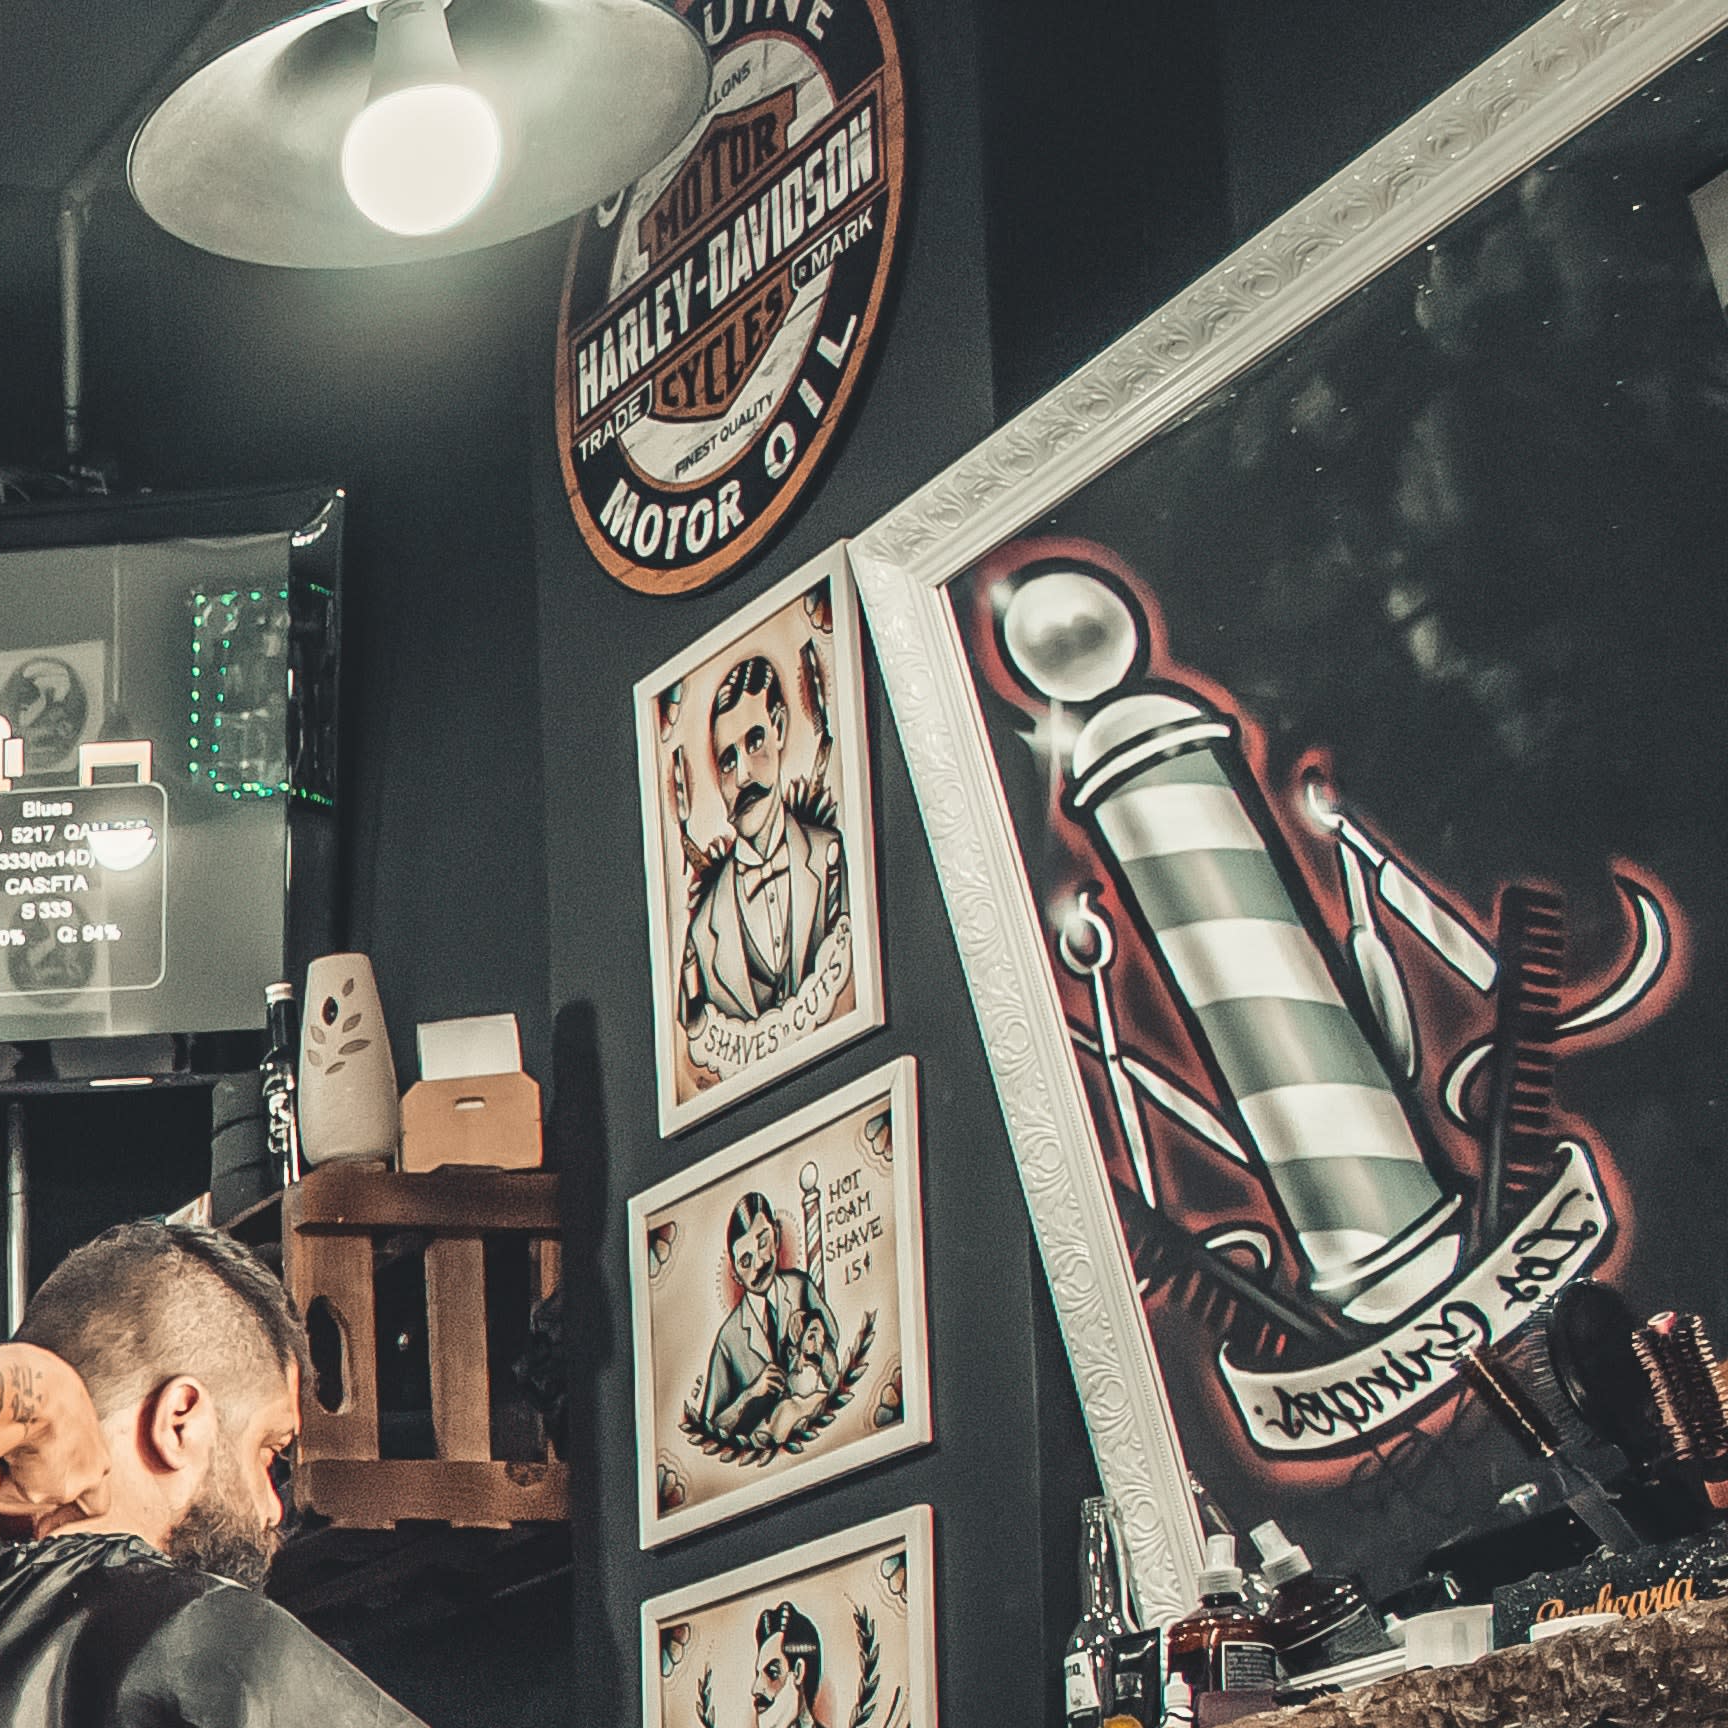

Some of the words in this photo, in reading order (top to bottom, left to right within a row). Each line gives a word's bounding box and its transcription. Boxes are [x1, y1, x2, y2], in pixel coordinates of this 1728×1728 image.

[578, 107, 874, 418] HARLEY-DAVIDSON
[811, 206, 874, 278] MARK
[661, 281, 785, 409] CYCLES
[578, 394, 642, 462] TRADE
[600, 478, 745, 560] MOTOR
[764, 314, 858, 480] OIL
[675, 432, 719, 479] FINEST
[718, 390, 775, 443] QUALITY
[11, 825, 56, 844] 5217
[22, 801, 73, 818] Blues
[5, 875, 89, 896] CAS:FTA
[705, 1025, 779, 1065] SHAVES
[793, 951, 842, 1031] CUTS
[825, 1191, 871, 1233] FOAM
[828, 1169, 861, 1203] HOT
[825, 1216, 883, 1262] SHAVE
